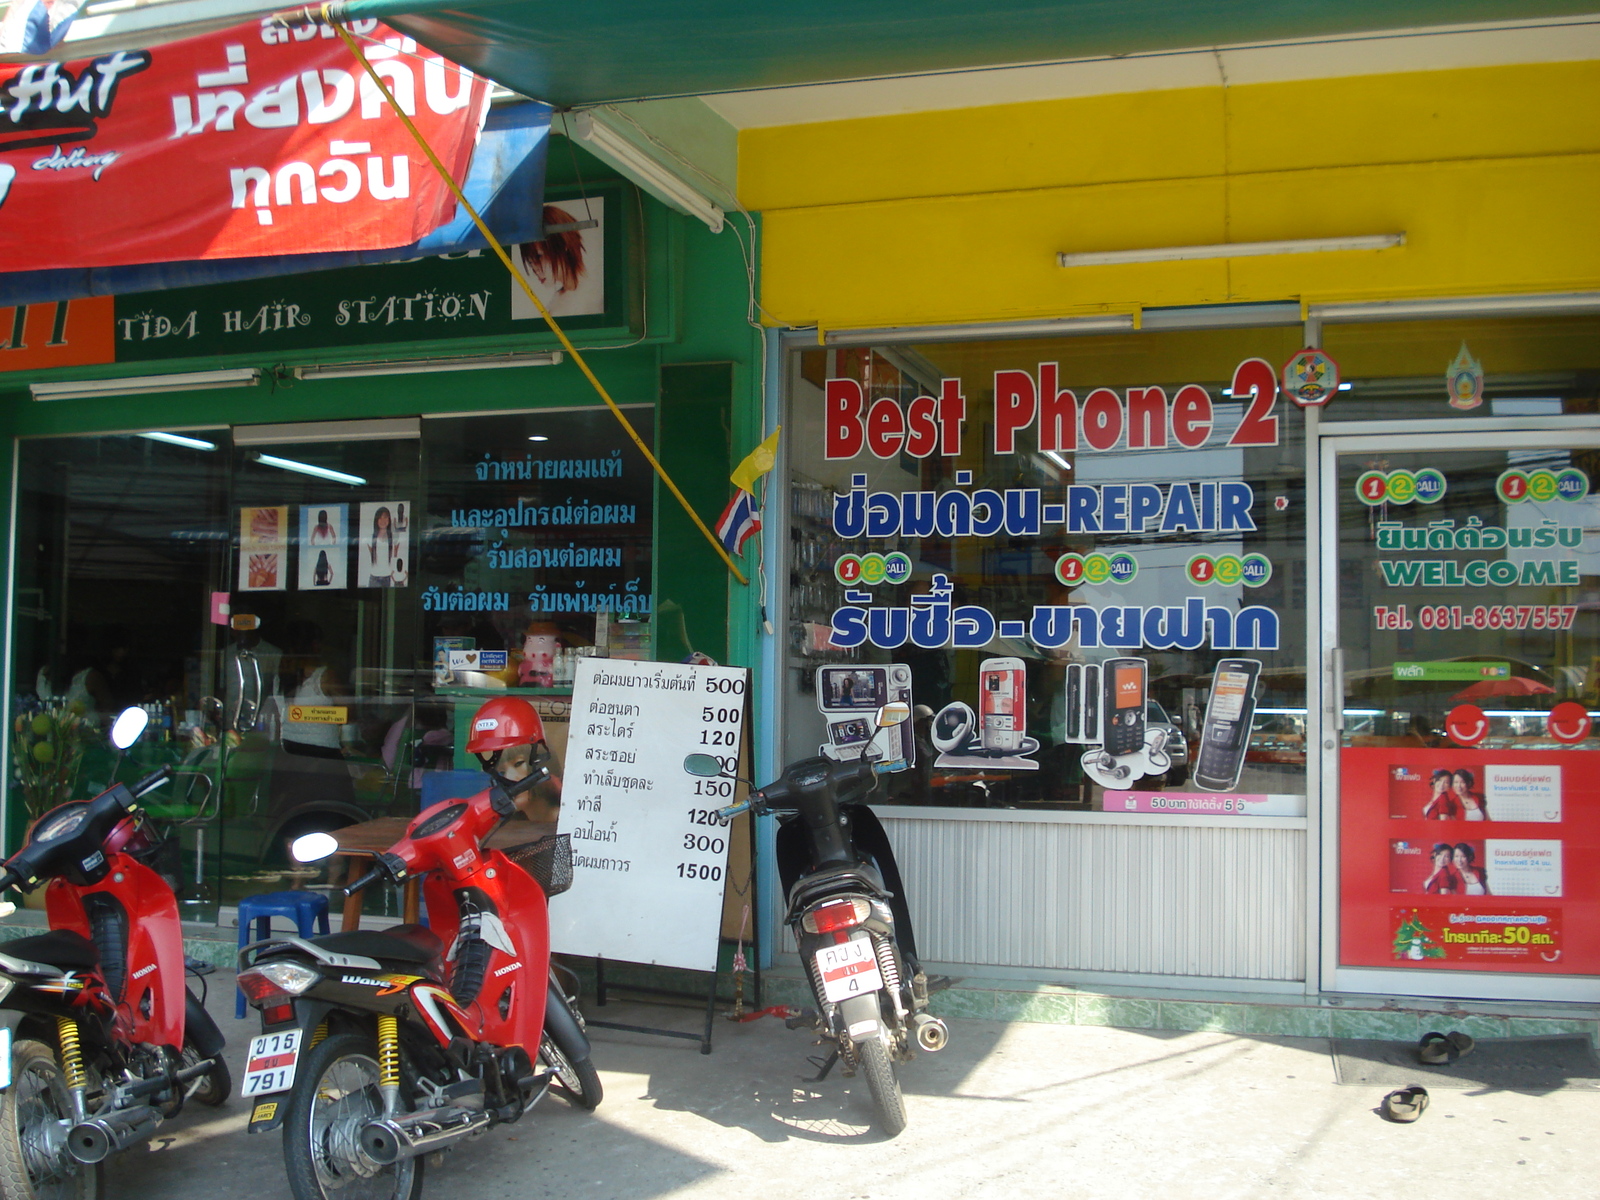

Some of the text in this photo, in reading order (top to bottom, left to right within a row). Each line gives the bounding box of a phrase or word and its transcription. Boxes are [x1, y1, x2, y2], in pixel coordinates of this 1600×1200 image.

[9, 51, 145, 123] Hut
[168, 37, 473, 140] เที่ยงคืน
[230, 140, 410, 225] ทุกวัน
[824, 357, 1279, 460] Best Phone 2
[475, 449, 623, 481] จำหน่ายผมแท้
[451, 497, 636, 538] และอุปกรณ์ต่อผม
[1377, 516, 1583, 550] ยินดีต้อนรับ
[486, 542, 621, 568] รับสอนต่อผม
[1380, 560, 1580, 586] WELCOME
[421, 585, 509, 611] รับต่อผม
[828, 573, 1279, 650] รับซื้อ-ขายฝาก
[1374, 604, 1578, 630] Tel. 081-8637557
[593, 670, 746, 695] ต่อผมยาวเริ่มต้นที่ 500
[589, 698, 739, 724] ต่อขนตา 500
[587, 717, 735, 746] สระไดร์ 120
[583, 769, 732, 798] ทำเล็บชุดละ 150
[578, 795, 602, 812] ทำสี
[1152, 798, 1166, 808] 50
[1168, 799, 1186, 809] บาท
[1224, 800, 1232, 810] 5
[573, 820, 724, 854] อบไอน้ำ 300
[676, 862, 722, 882] 1500
[1503, 926, 1531, 944] 50
[132, 963, 157, 980] HONDA
[341, 975, 391, 988] Wave
[494, 962, 522, 977] HONDA
[849, 978, 859, 991] 4
[249, 1070, 285, 1093] 791
